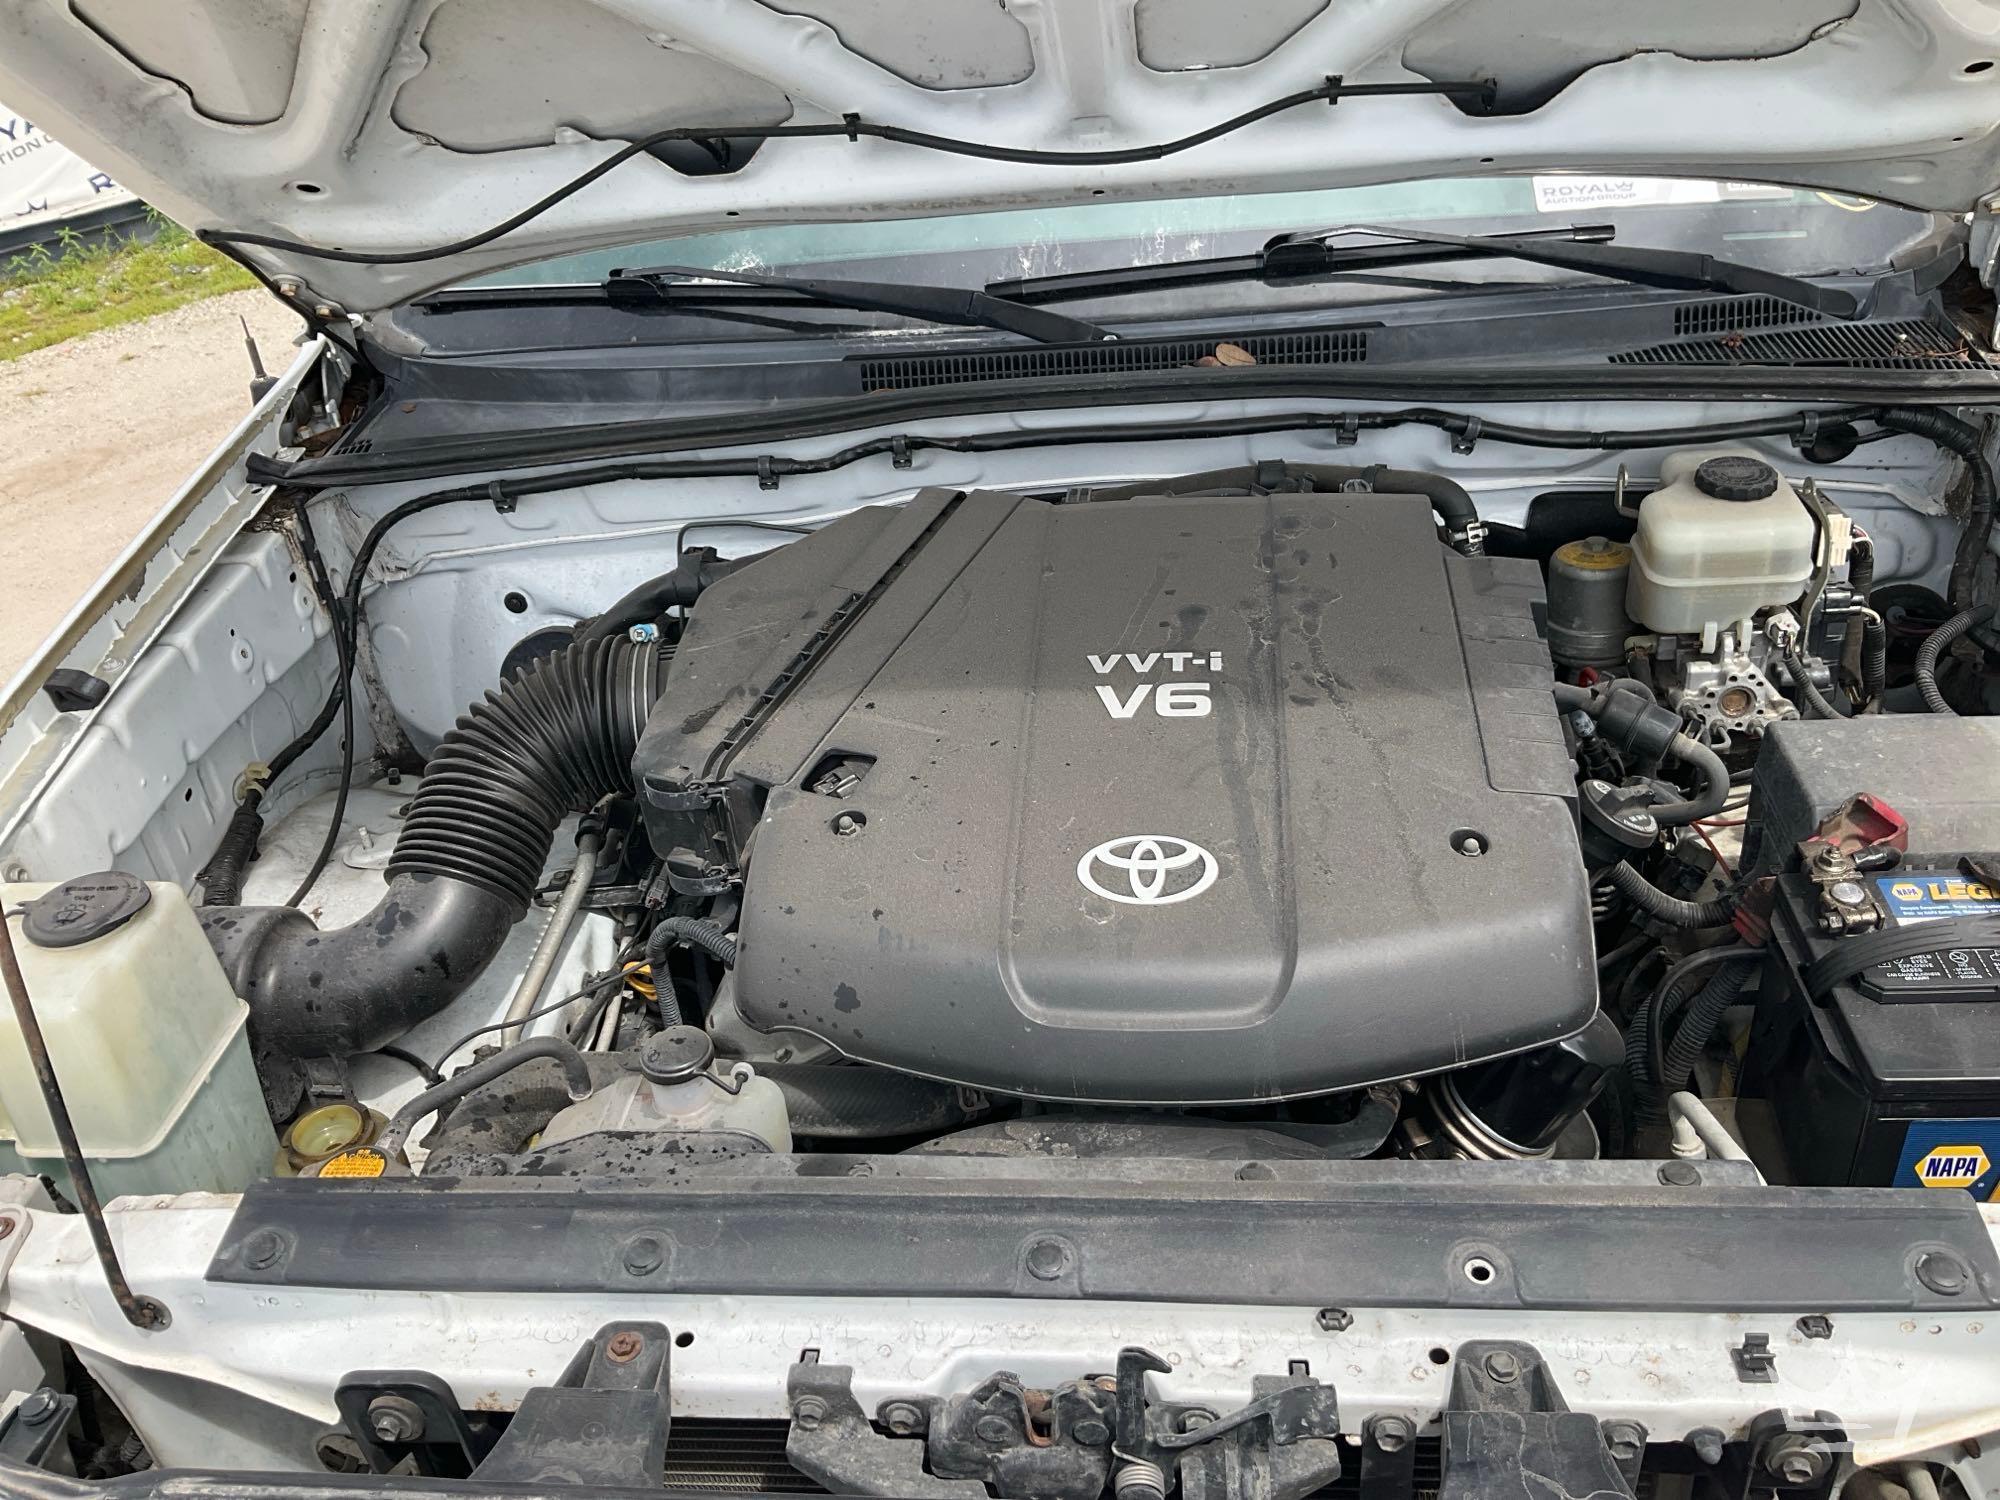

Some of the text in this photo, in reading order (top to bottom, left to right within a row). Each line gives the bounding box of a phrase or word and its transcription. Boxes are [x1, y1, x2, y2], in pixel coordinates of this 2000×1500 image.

[1543, 182, 1615, 197] ROYAL
[1546, 192, 1637, 205] AUCTION GROUP
[1087, 651, 1223, 674] VVT-i
[1095, 683, 1213, 719] V6
[1896, 888, 1919, 897] NAPA
[1925, 1157, 1978, 1178] NAPA
